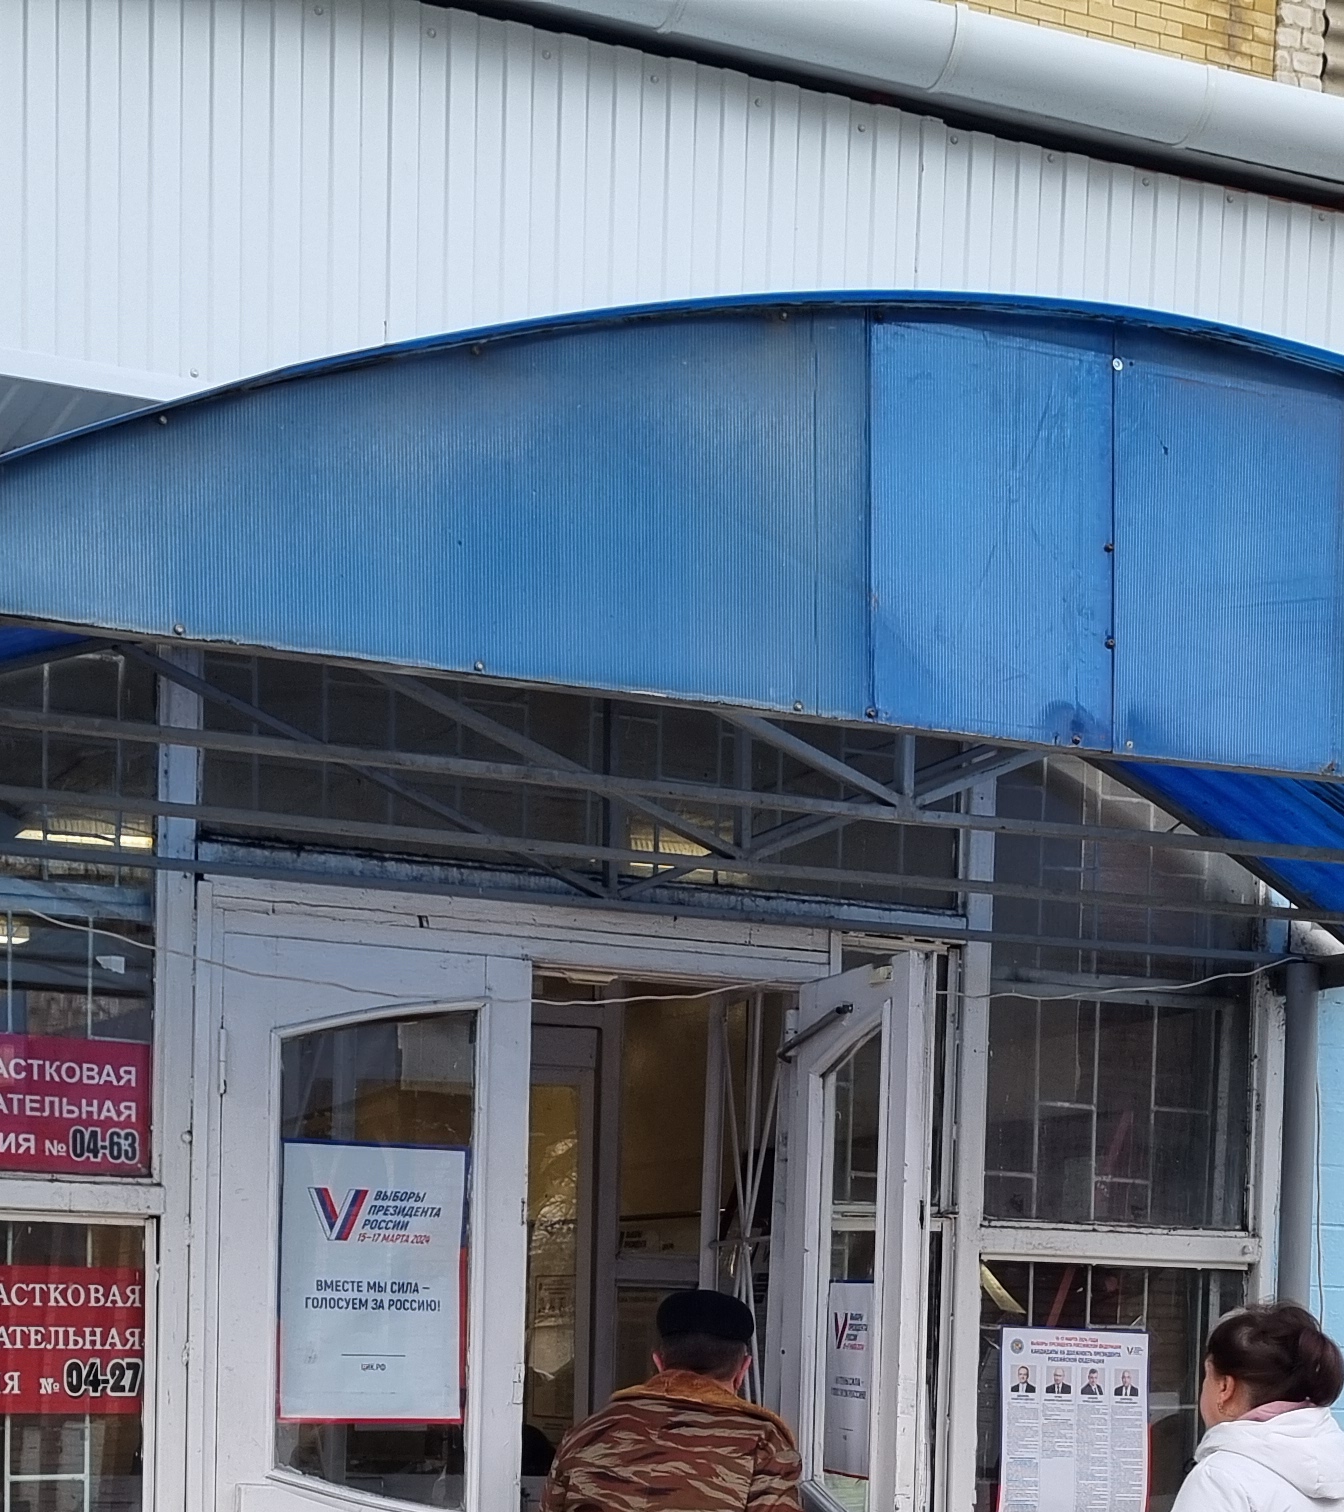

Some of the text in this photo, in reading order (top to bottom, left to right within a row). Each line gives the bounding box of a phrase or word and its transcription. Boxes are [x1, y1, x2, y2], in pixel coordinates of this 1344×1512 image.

[69, 1125, 140, 1164] 04-63
[373, 1190, 426, 1203] ВЫБОРЫ
[367, 1204, 442, 1219] ПРЕЗИДЕНТА
[362, 1219, 409, 1231] РОССИИ
[381, 1233, 409, 1244] МАРТА
[410, 1234, 430, 1245] 2024
[315, 1279, 364, 1293] ВМЕСТЕ
[366, 1280, 387, 1293] МЫ
[390, 1281, 419, 1294] СИЛА
[304, 1296, 441, 1312] ГОЛОСУЕМ ЗА РОССИЮ!
[63, 1357, 143, 1397] 04-27
